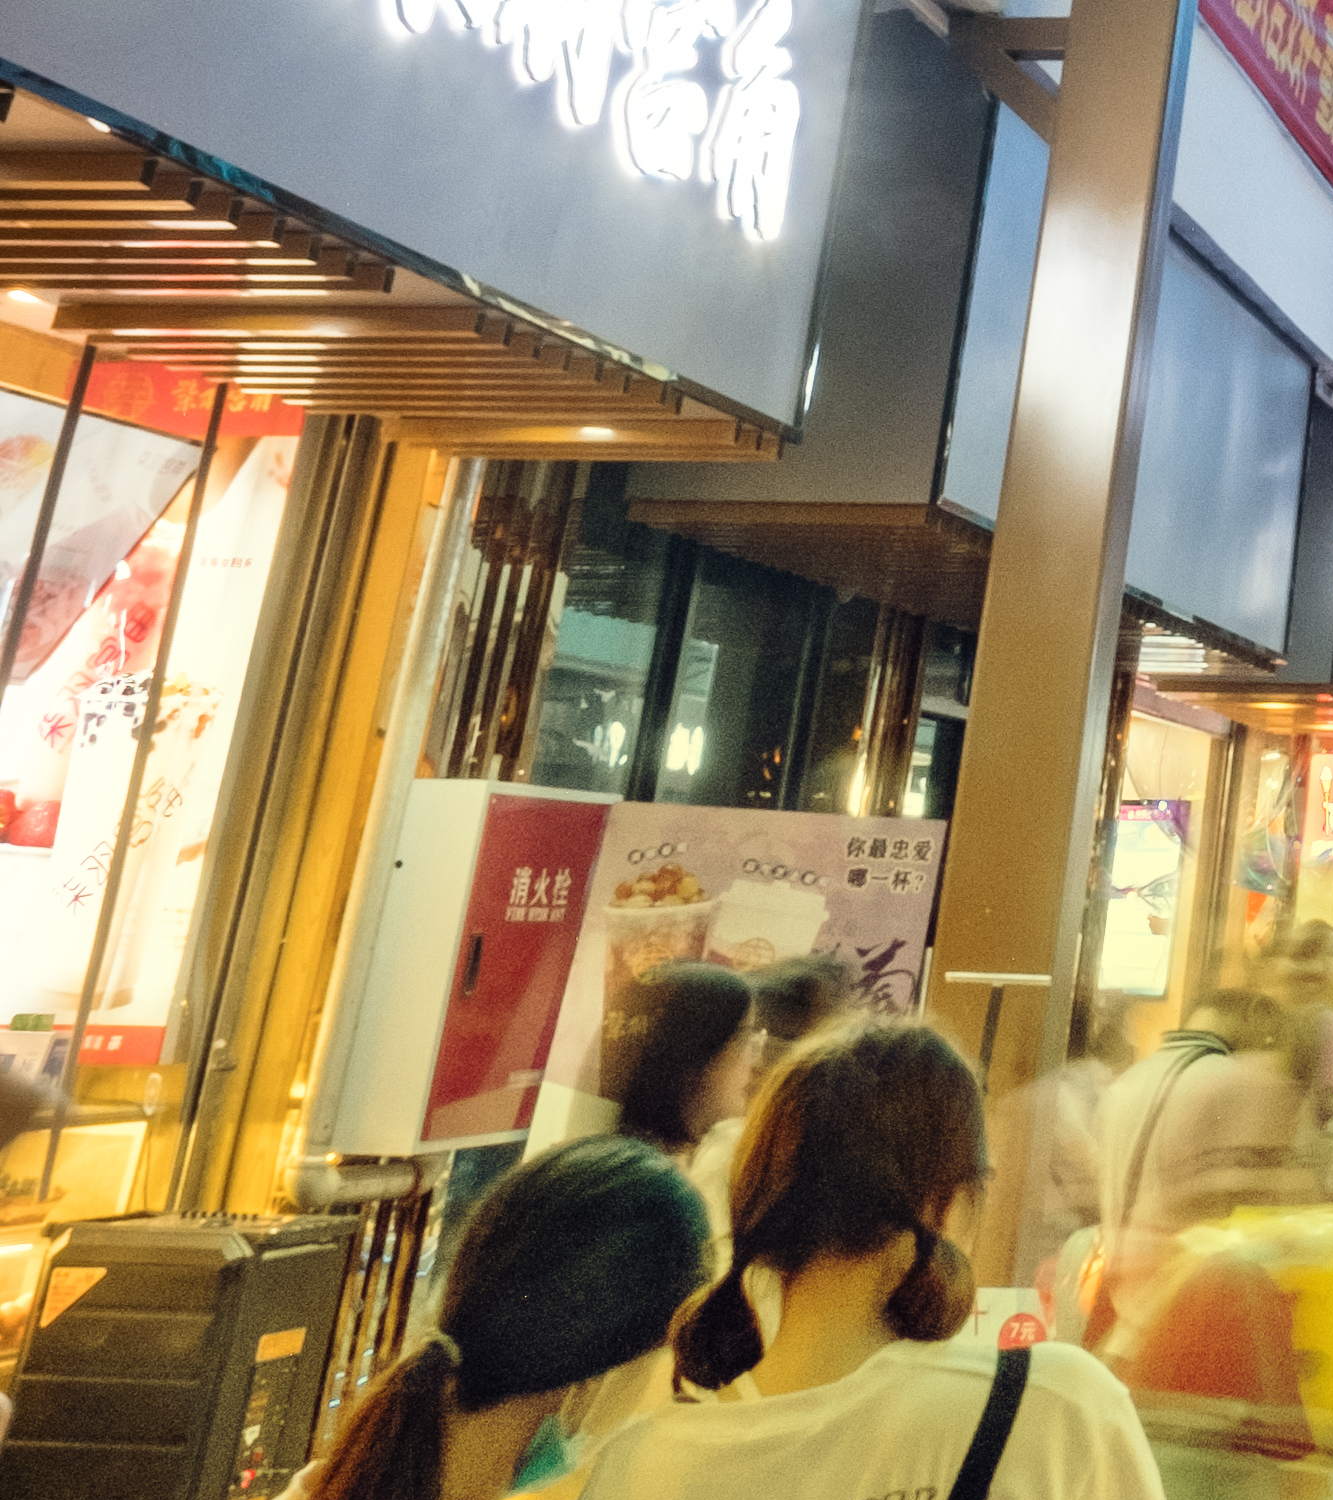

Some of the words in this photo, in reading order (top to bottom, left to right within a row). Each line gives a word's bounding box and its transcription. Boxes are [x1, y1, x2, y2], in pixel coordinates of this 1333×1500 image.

[509, 865, 573, 907] 消火栓
[1009, 1321, 1037, 1341] 7元
